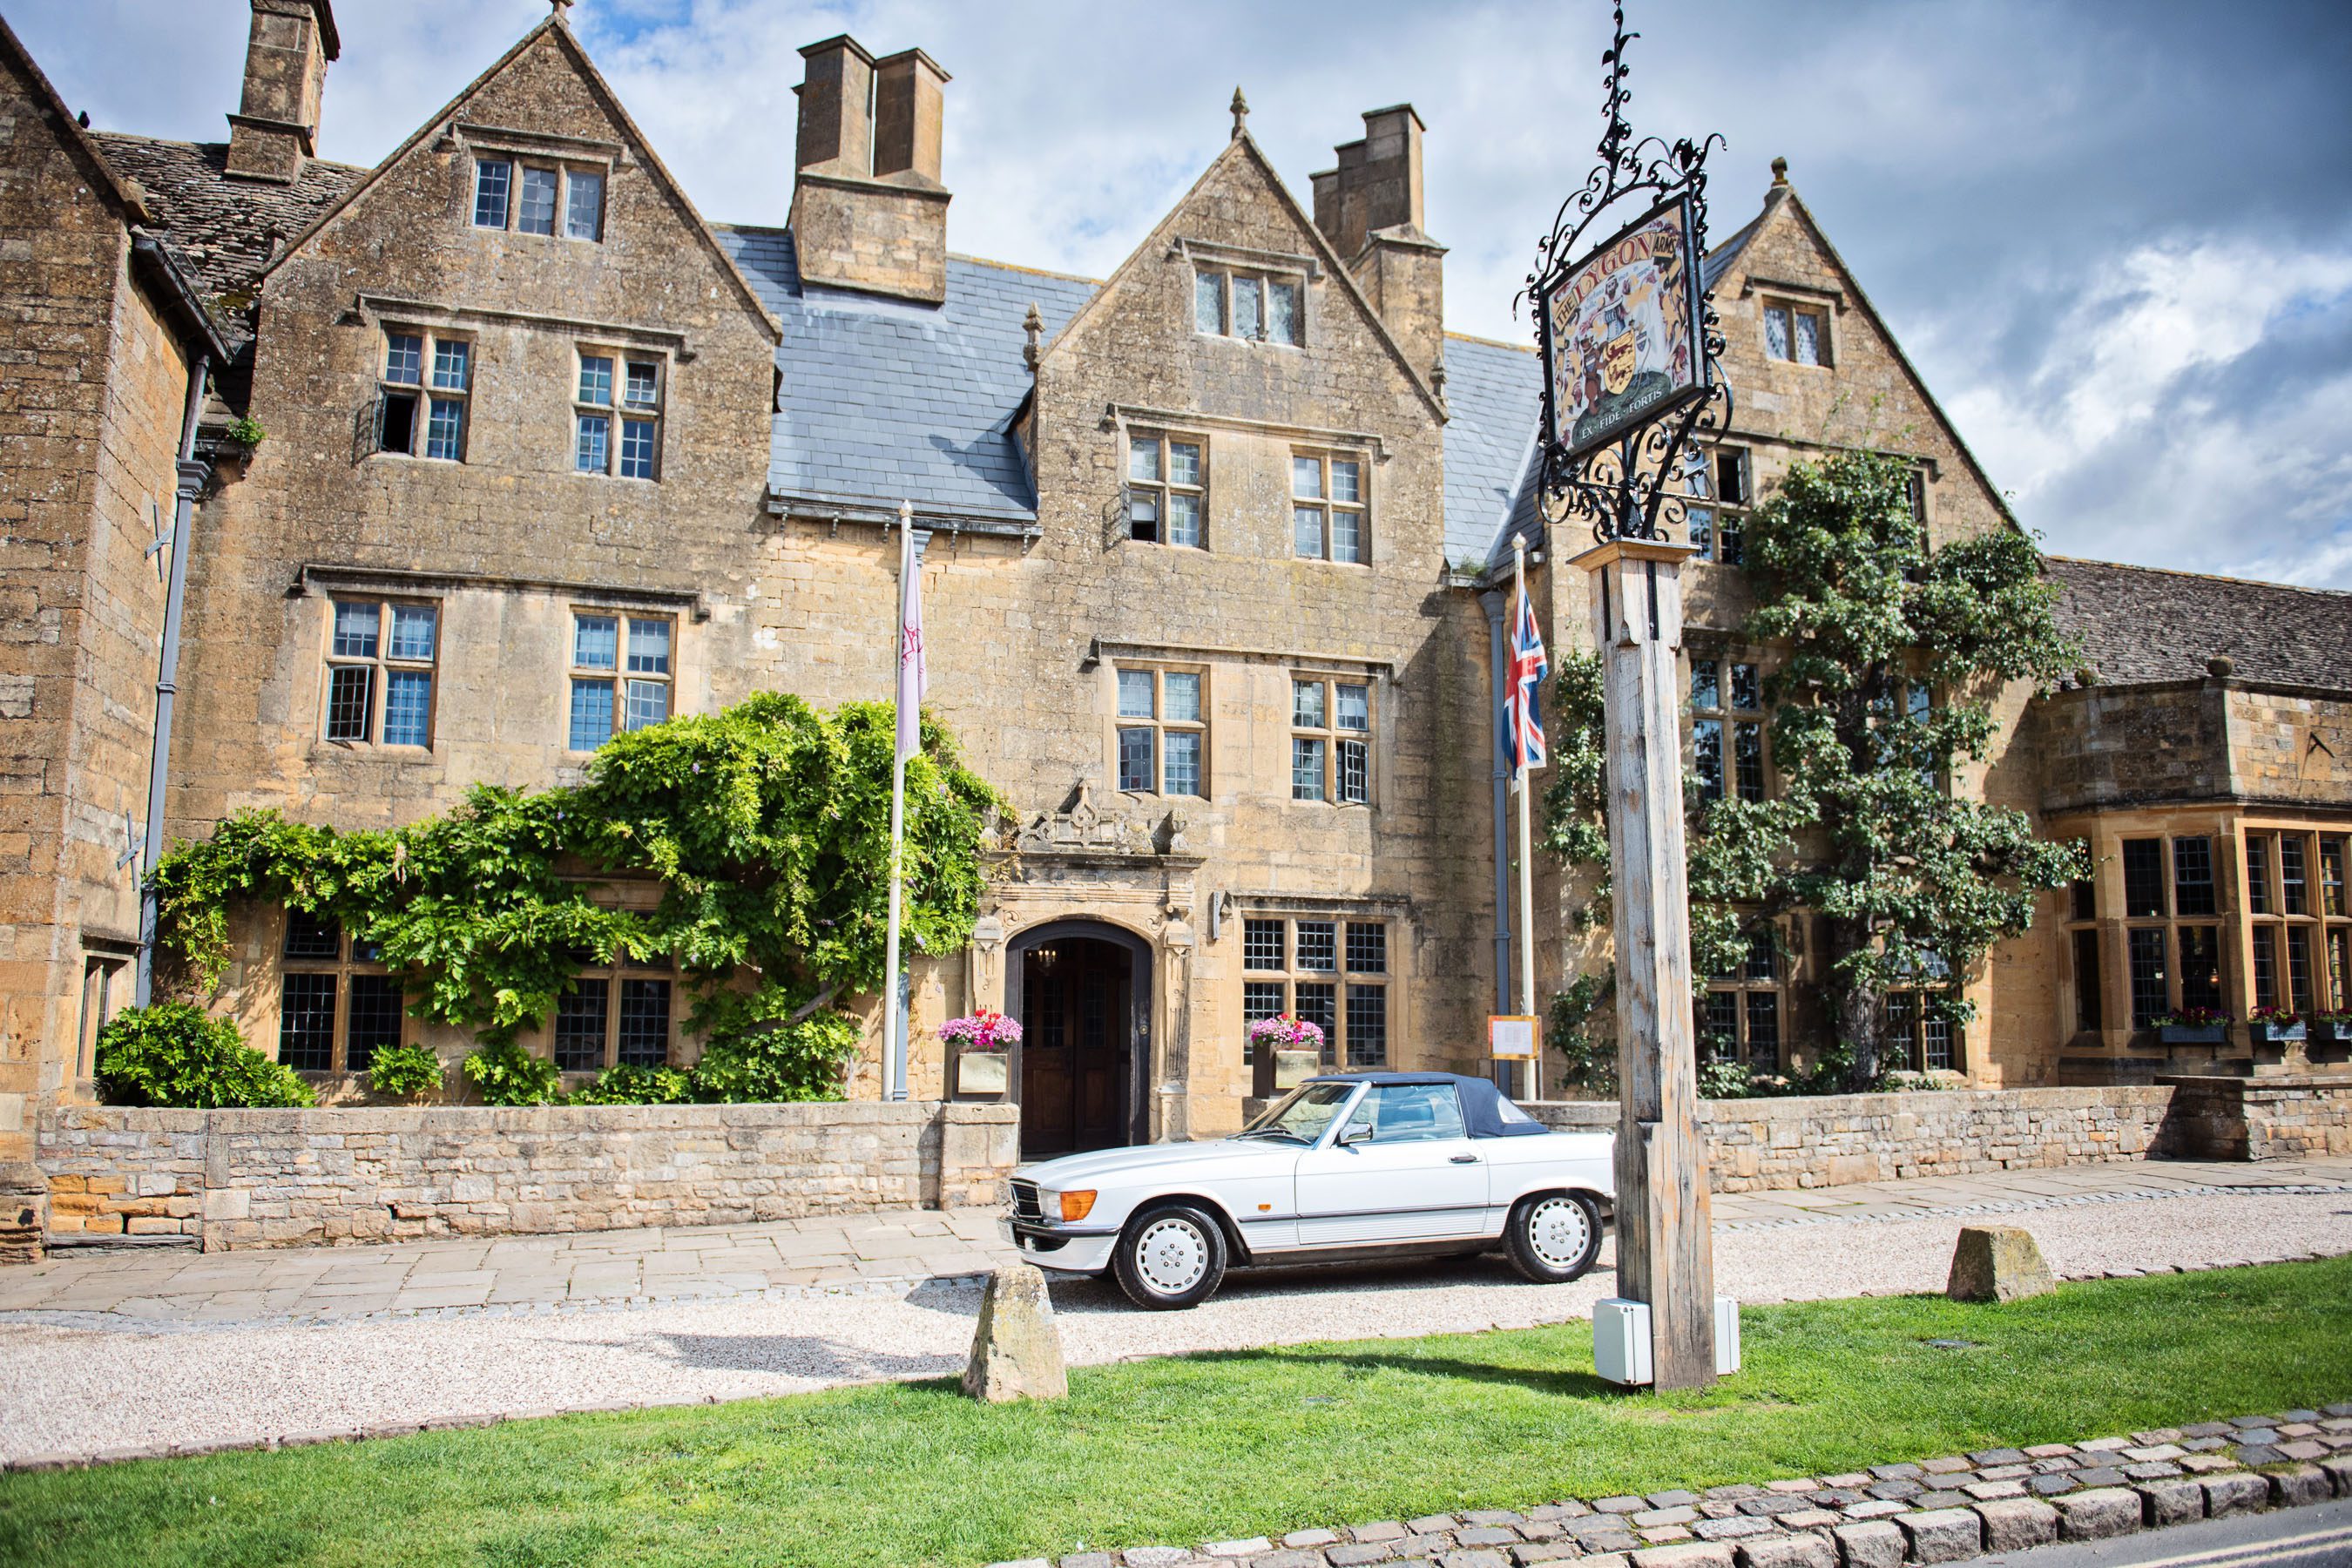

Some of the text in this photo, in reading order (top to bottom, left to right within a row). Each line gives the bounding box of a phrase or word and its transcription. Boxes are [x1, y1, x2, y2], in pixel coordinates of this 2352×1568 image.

[1556, 296, 1575, 325] THE
[1572, 233, 1655, 304] LYGON
[1653, 236, 1677, 253] ARMS
[1582, 389, 1662, 439] EX FIDE FORTIS
